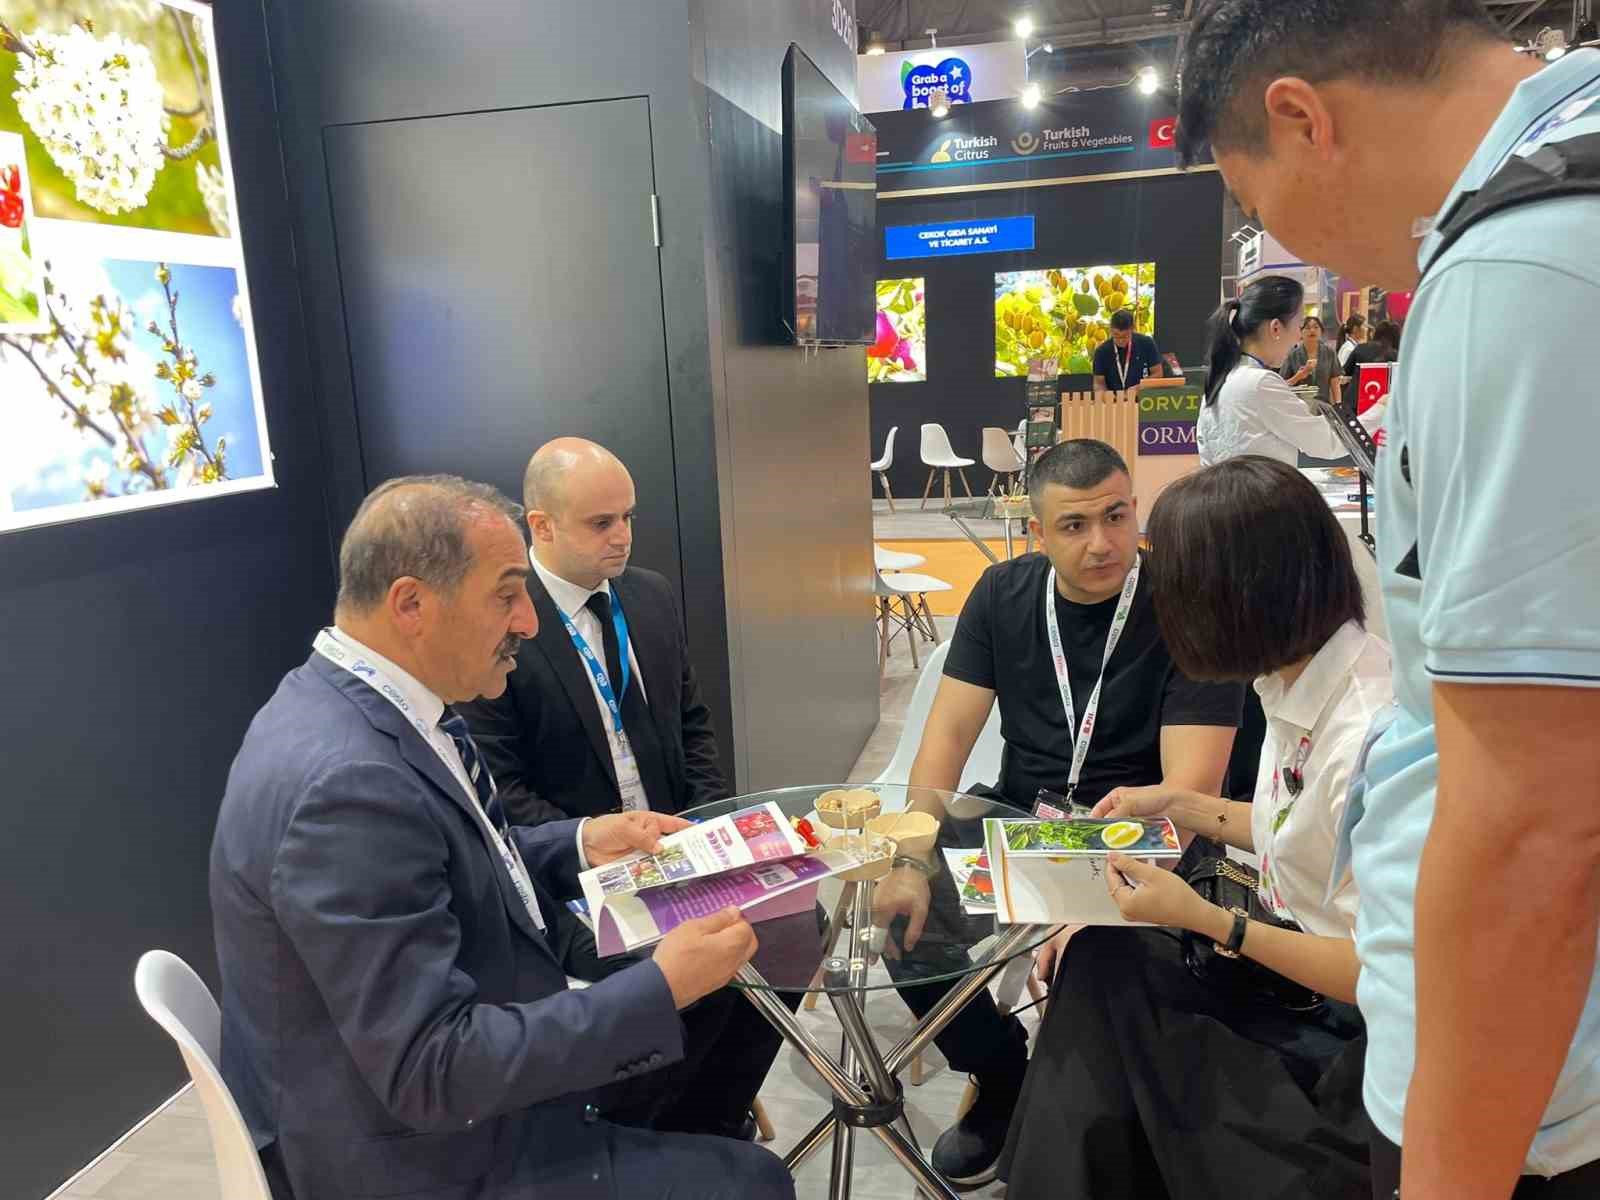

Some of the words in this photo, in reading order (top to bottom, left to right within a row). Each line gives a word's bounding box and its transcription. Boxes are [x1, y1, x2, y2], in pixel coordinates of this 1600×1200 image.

[912, 73, 939, 85] Grab
[940, 74, 947, 83] a
[950, 81, 965, 96] of
[1042, 126, 1090, 140] Turkish
[953, 136, 998, 149] Turkish
[1043, 140, 1070, 151] Fruits
[1071, 138, 1079, 148] &
[1080, 134, 1133, 148] Vegetables
[954, 149, 990, 161] Citrus
